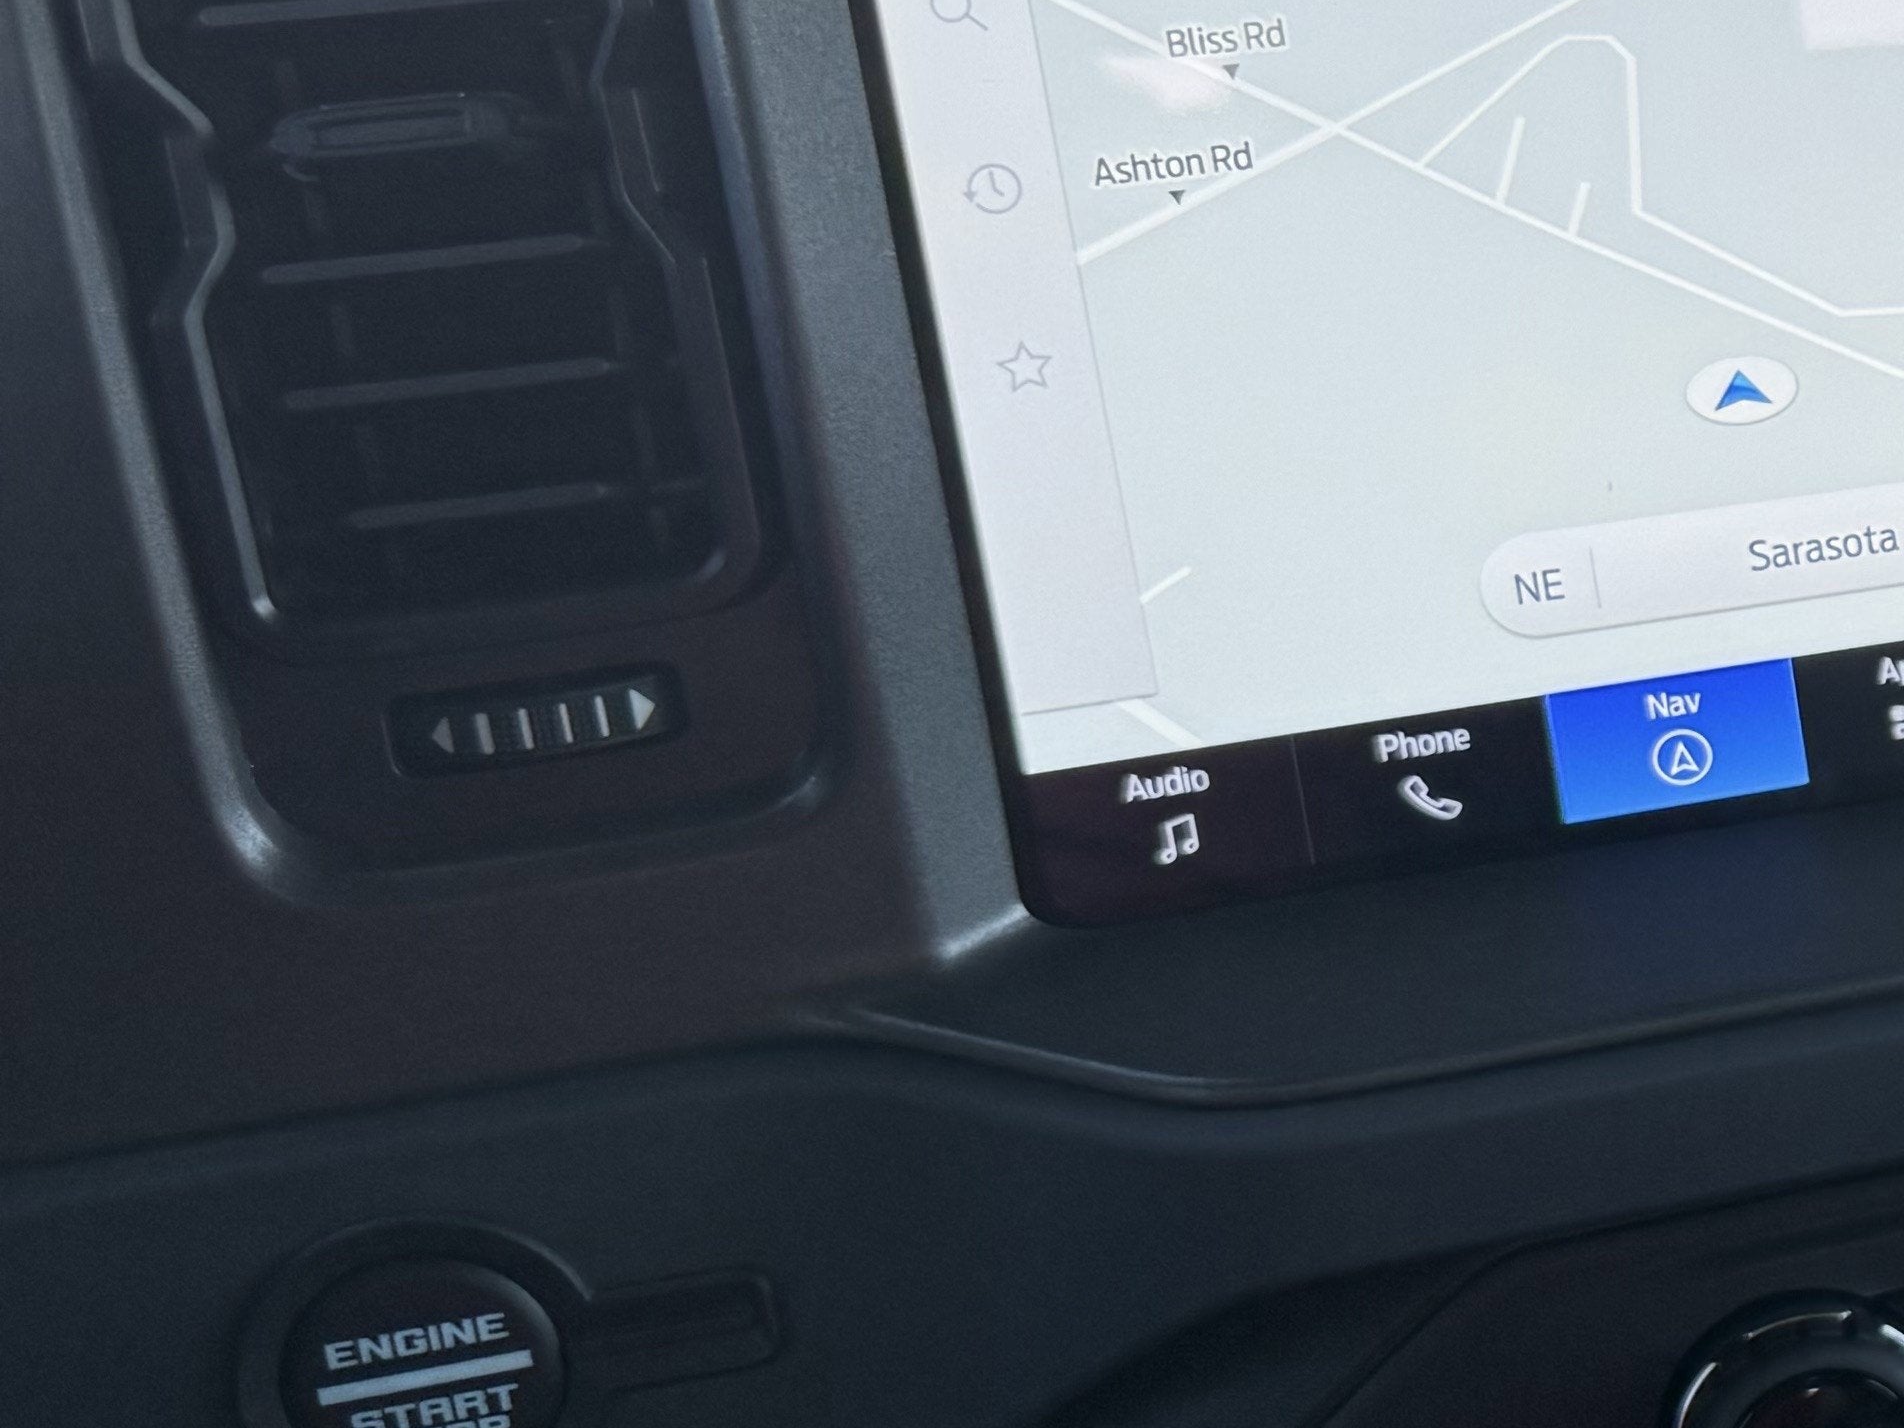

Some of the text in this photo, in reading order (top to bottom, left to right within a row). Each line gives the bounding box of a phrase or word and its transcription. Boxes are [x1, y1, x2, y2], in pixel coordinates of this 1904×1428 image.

[1167, 19, 1285, 57] Bliss Rd
[1096, 142, 1252, 185] Ashton Rd
[1749, 527, 1899, 571] Sarasota
[1514, 569, 1564, 604] NE
[1647, 692, 1700, 719] Nav
[1373, 726, 1470, 762] Phone
[1123, 767, 1209, 802] Audio
[325, 1312, 510, 1370] ENGINE
